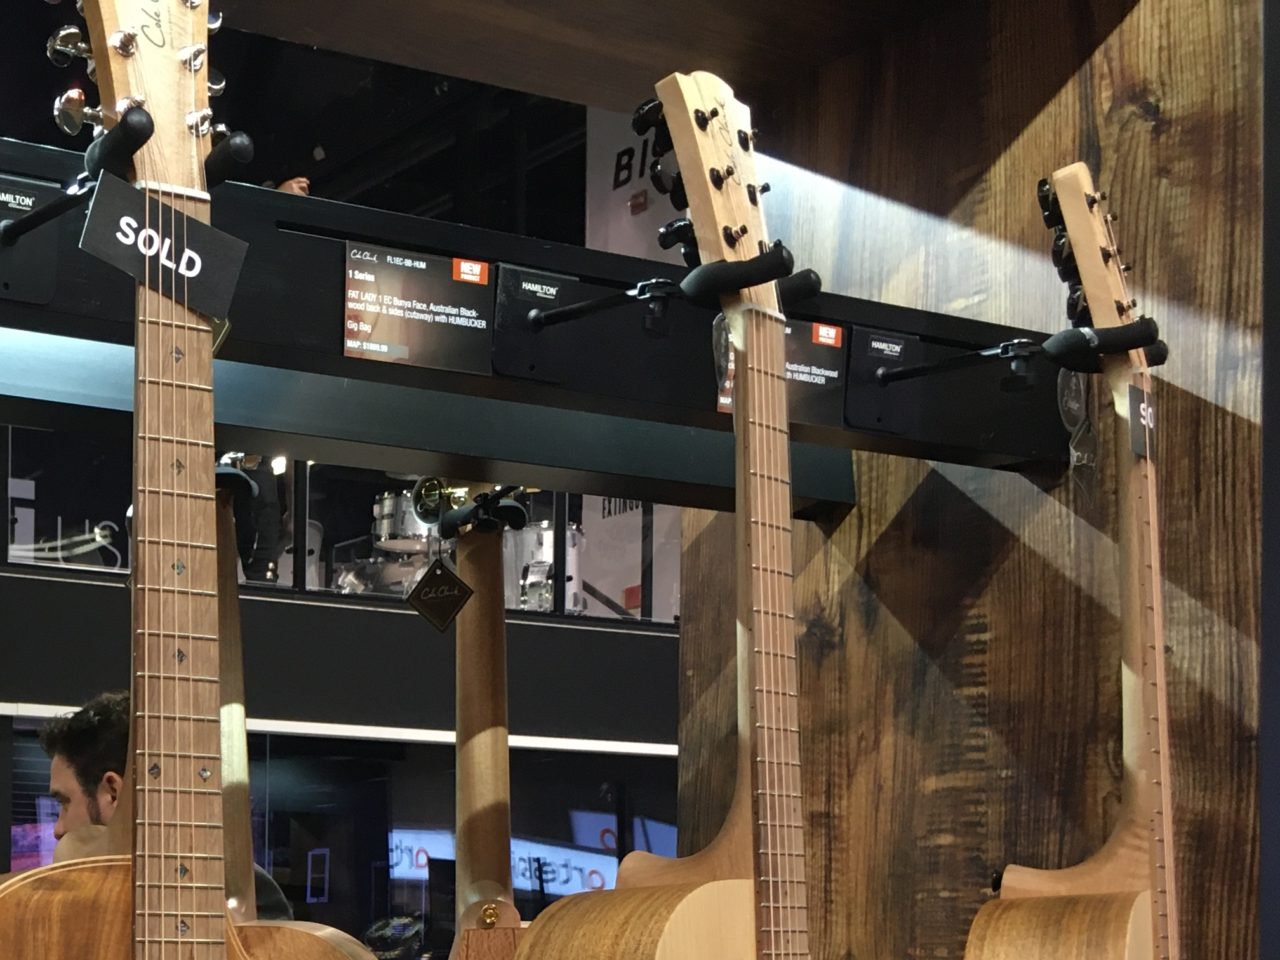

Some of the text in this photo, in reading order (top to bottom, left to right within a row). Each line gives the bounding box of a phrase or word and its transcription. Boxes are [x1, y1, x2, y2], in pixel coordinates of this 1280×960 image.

[612, 138, 650, 191] BI
[115, 216, 202, 278] SOLD
[354, 270, 375, 282] Series
[461, 261, 481, 275] NEW
[522, 281, 557, 296] HAMILTON
[347, 302, 365, 311] wood
[388, 308, 404, 317] sides
[434, 315, 448, 324] with
[448, 316, 487, 329] HUMBUCKER
[348, 290, 360, 300] FAT
[360, 292, 378, 303] LADY
[383, 295, 392, 305] EC
[429, 303, 459, 315] Australian
[460, 307, 479, 318] Black-
[347, 320, 372, 334] Gig Bag
[1140, 402, 1155, 429] SO
